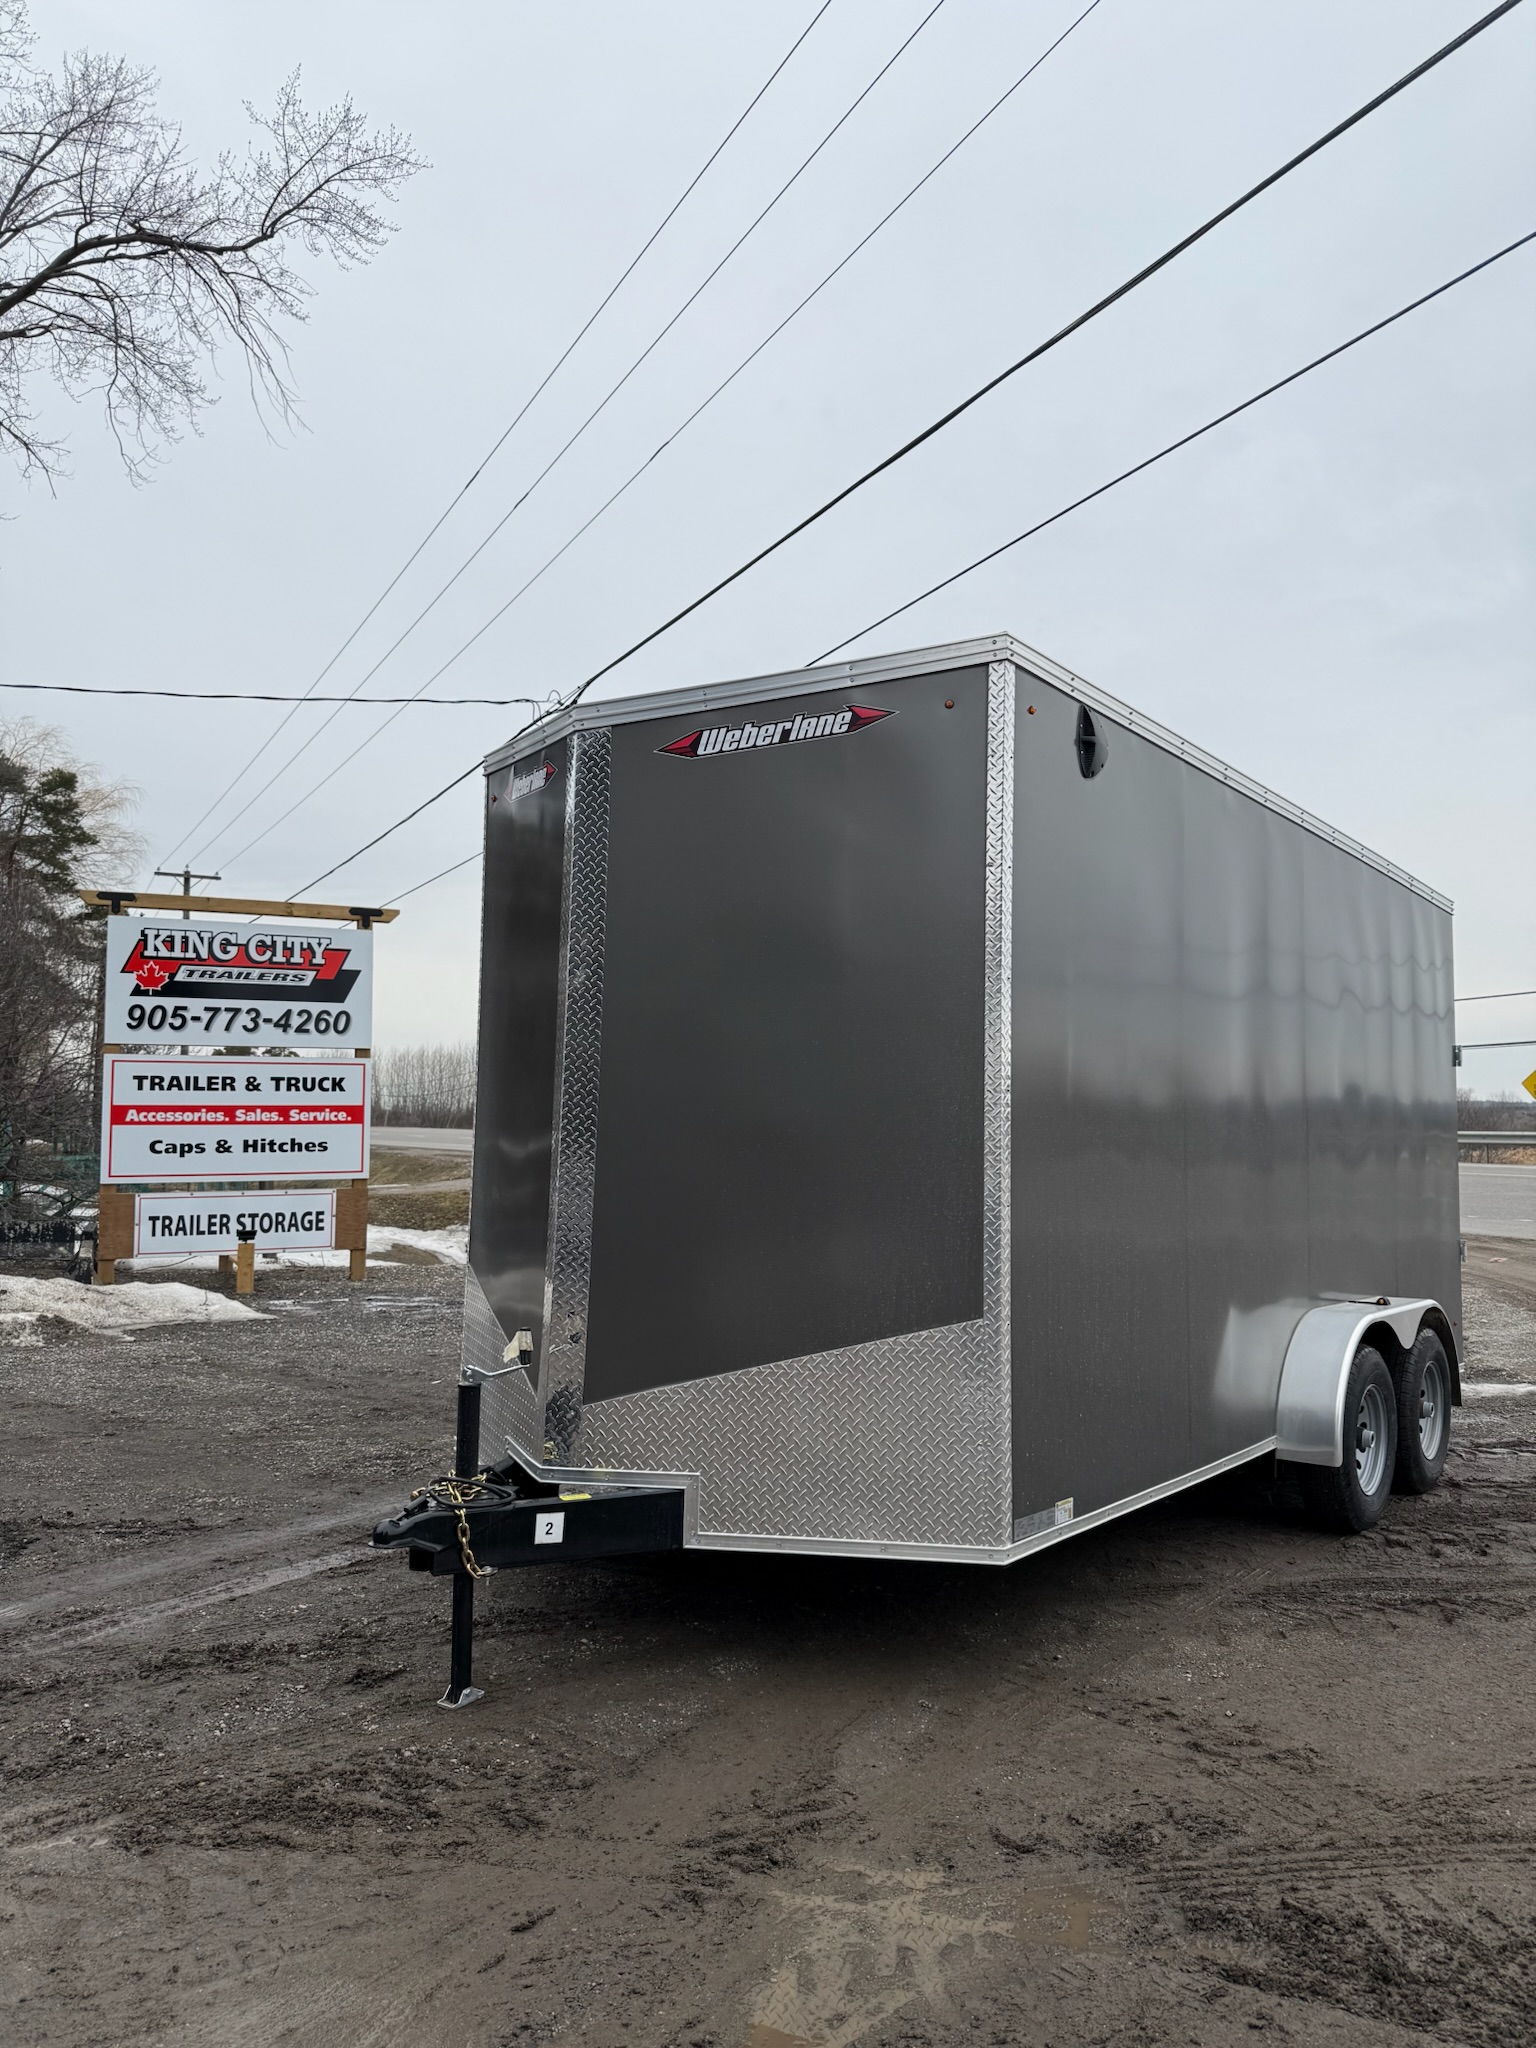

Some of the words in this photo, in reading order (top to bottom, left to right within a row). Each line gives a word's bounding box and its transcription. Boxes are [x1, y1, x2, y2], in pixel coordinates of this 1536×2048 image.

[696, 709, 853, 755] Weberlane
[141, 928, 238, 962] KING
[246, 934, 332, 966] CITY
[182, 968, 308, 983] TRAILERS
[126, 1004, 352, 1034] 905-773-4260
[133, 1075, 236, 1092] TRAILER
[245, 1076, 262, 1092] &
[270, 1076, 346, 1092] TRUCK
[125, 1109, 229, 1122] Accessories.
[235, 1109, 284, 1122] Sales.
[289, 1109, 352, 1122] Service.
[149, 1140, 206, 1158] Caps
[215, 1139, 233, 1154] &
[242, 1138, 329, 1153] Hitches
[148, 1214, 231, 1237] TRAILER
[236, 1210, 325, 1234] STORAGE
[545, 1522, 553, 1535] 2
